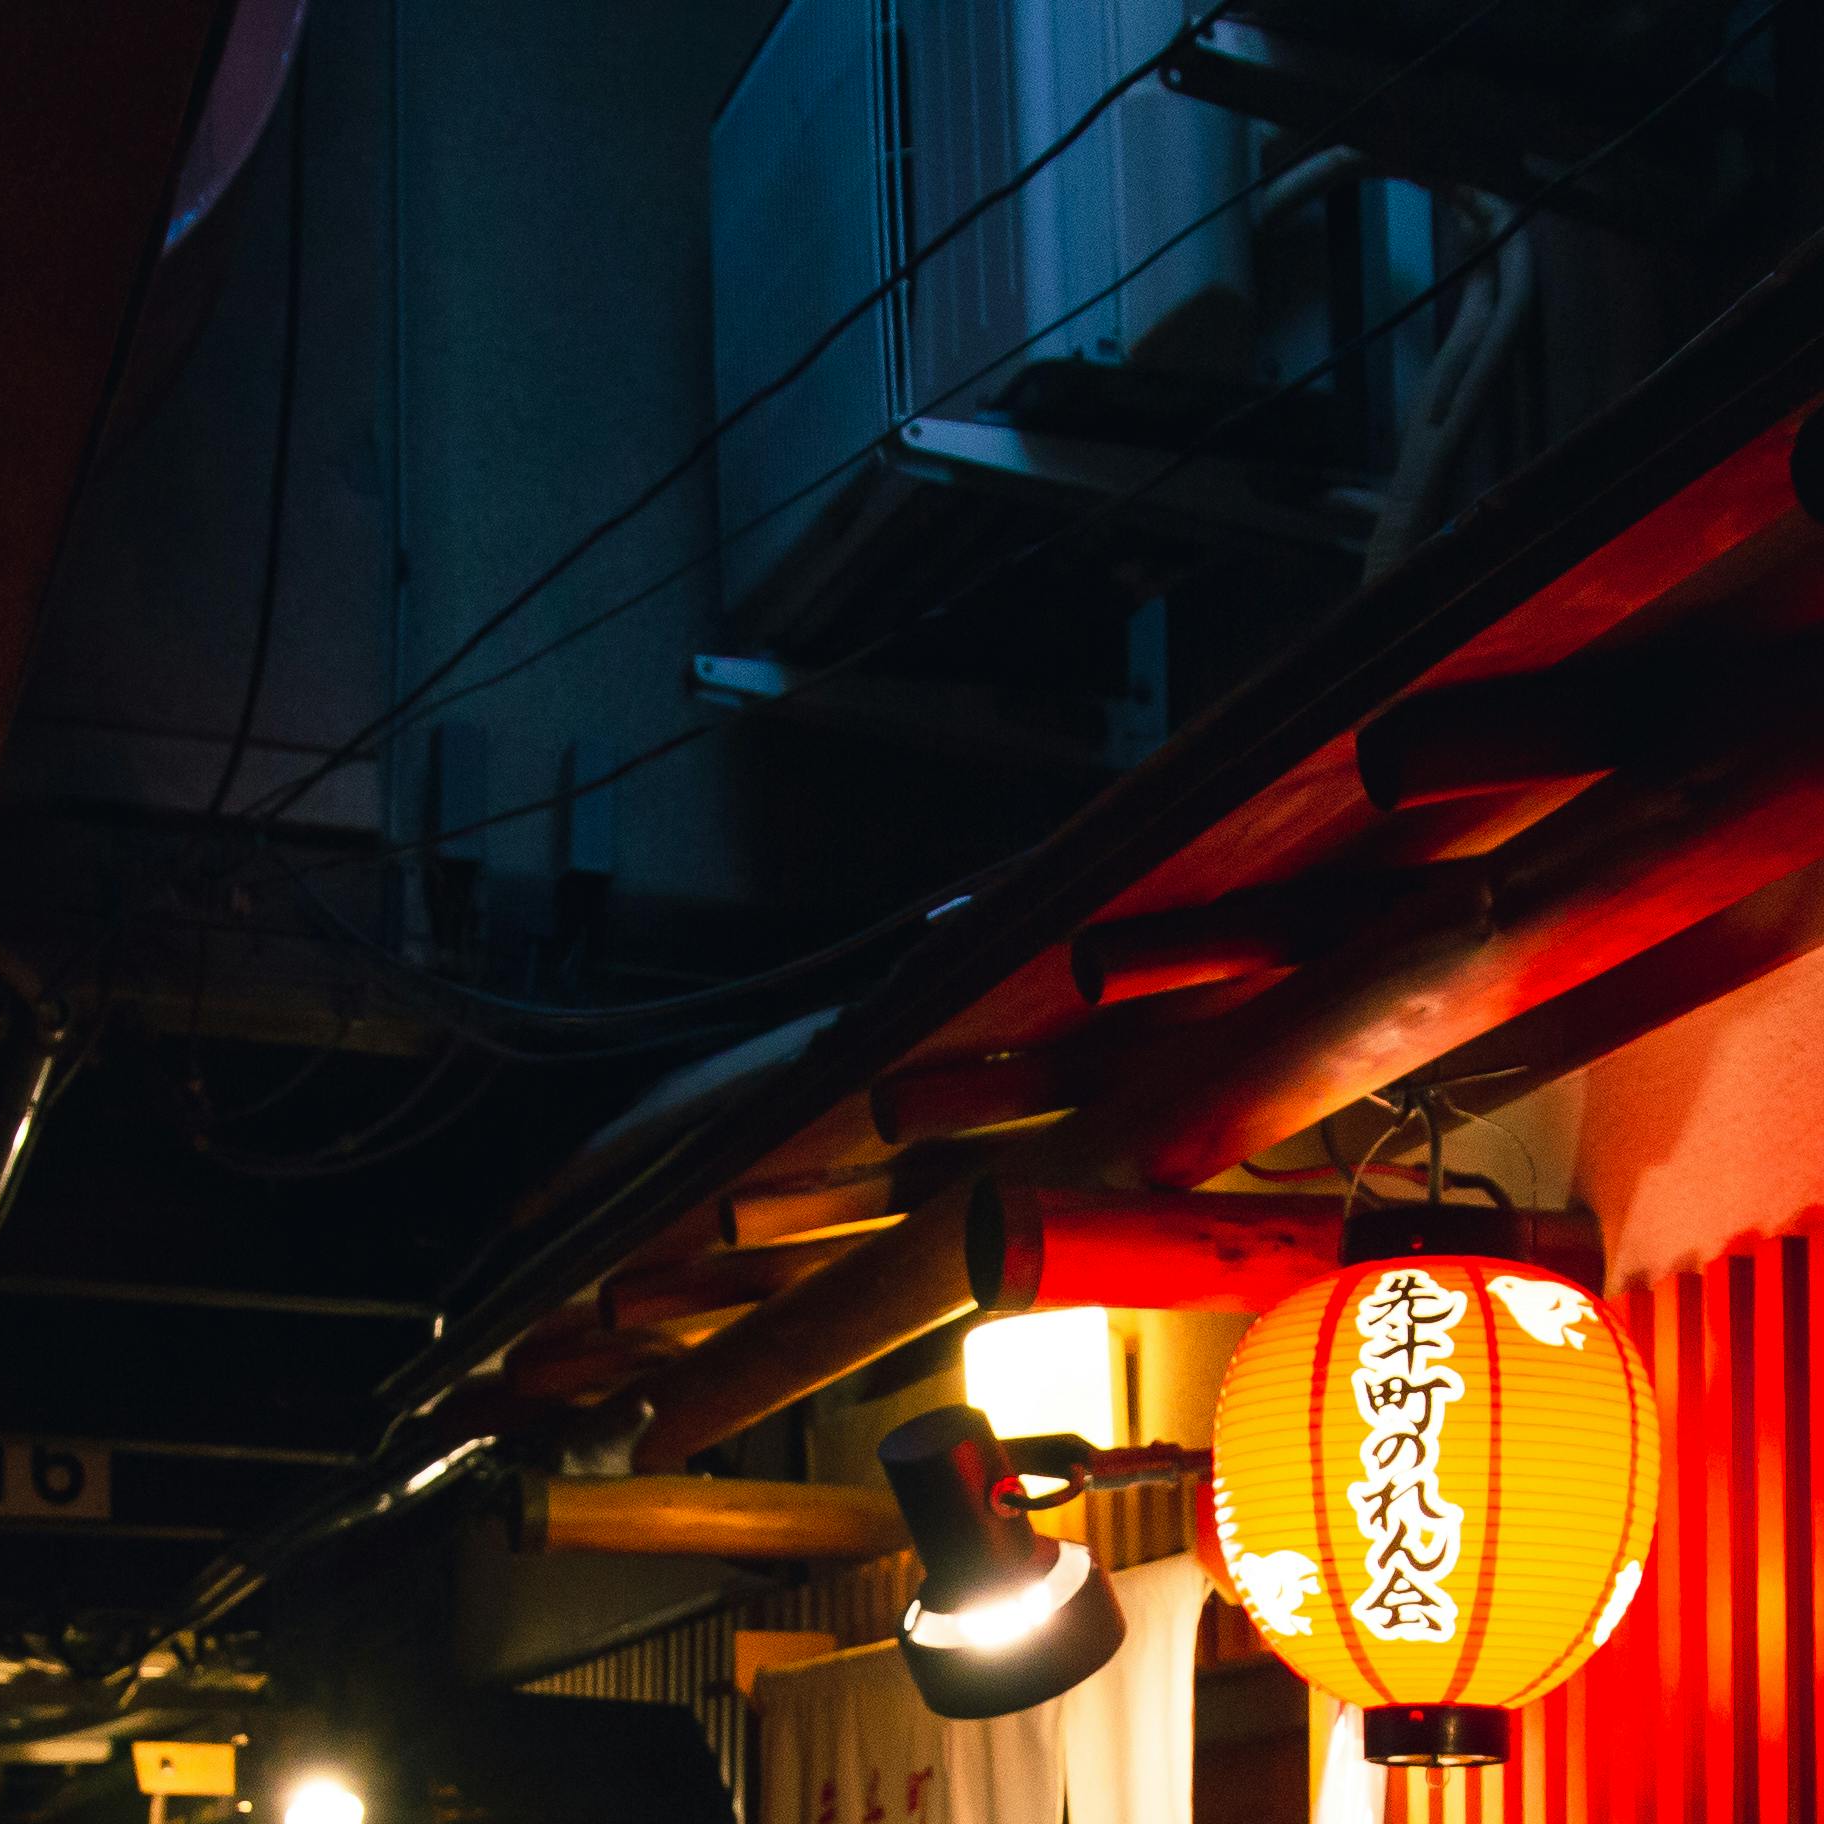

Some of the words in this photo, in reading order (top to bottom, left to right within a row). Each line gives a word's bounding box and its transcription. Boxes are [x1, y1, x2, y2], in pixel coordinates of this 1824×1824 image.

[1362, 1275, 1456, 1632] 先斗町のれん会
